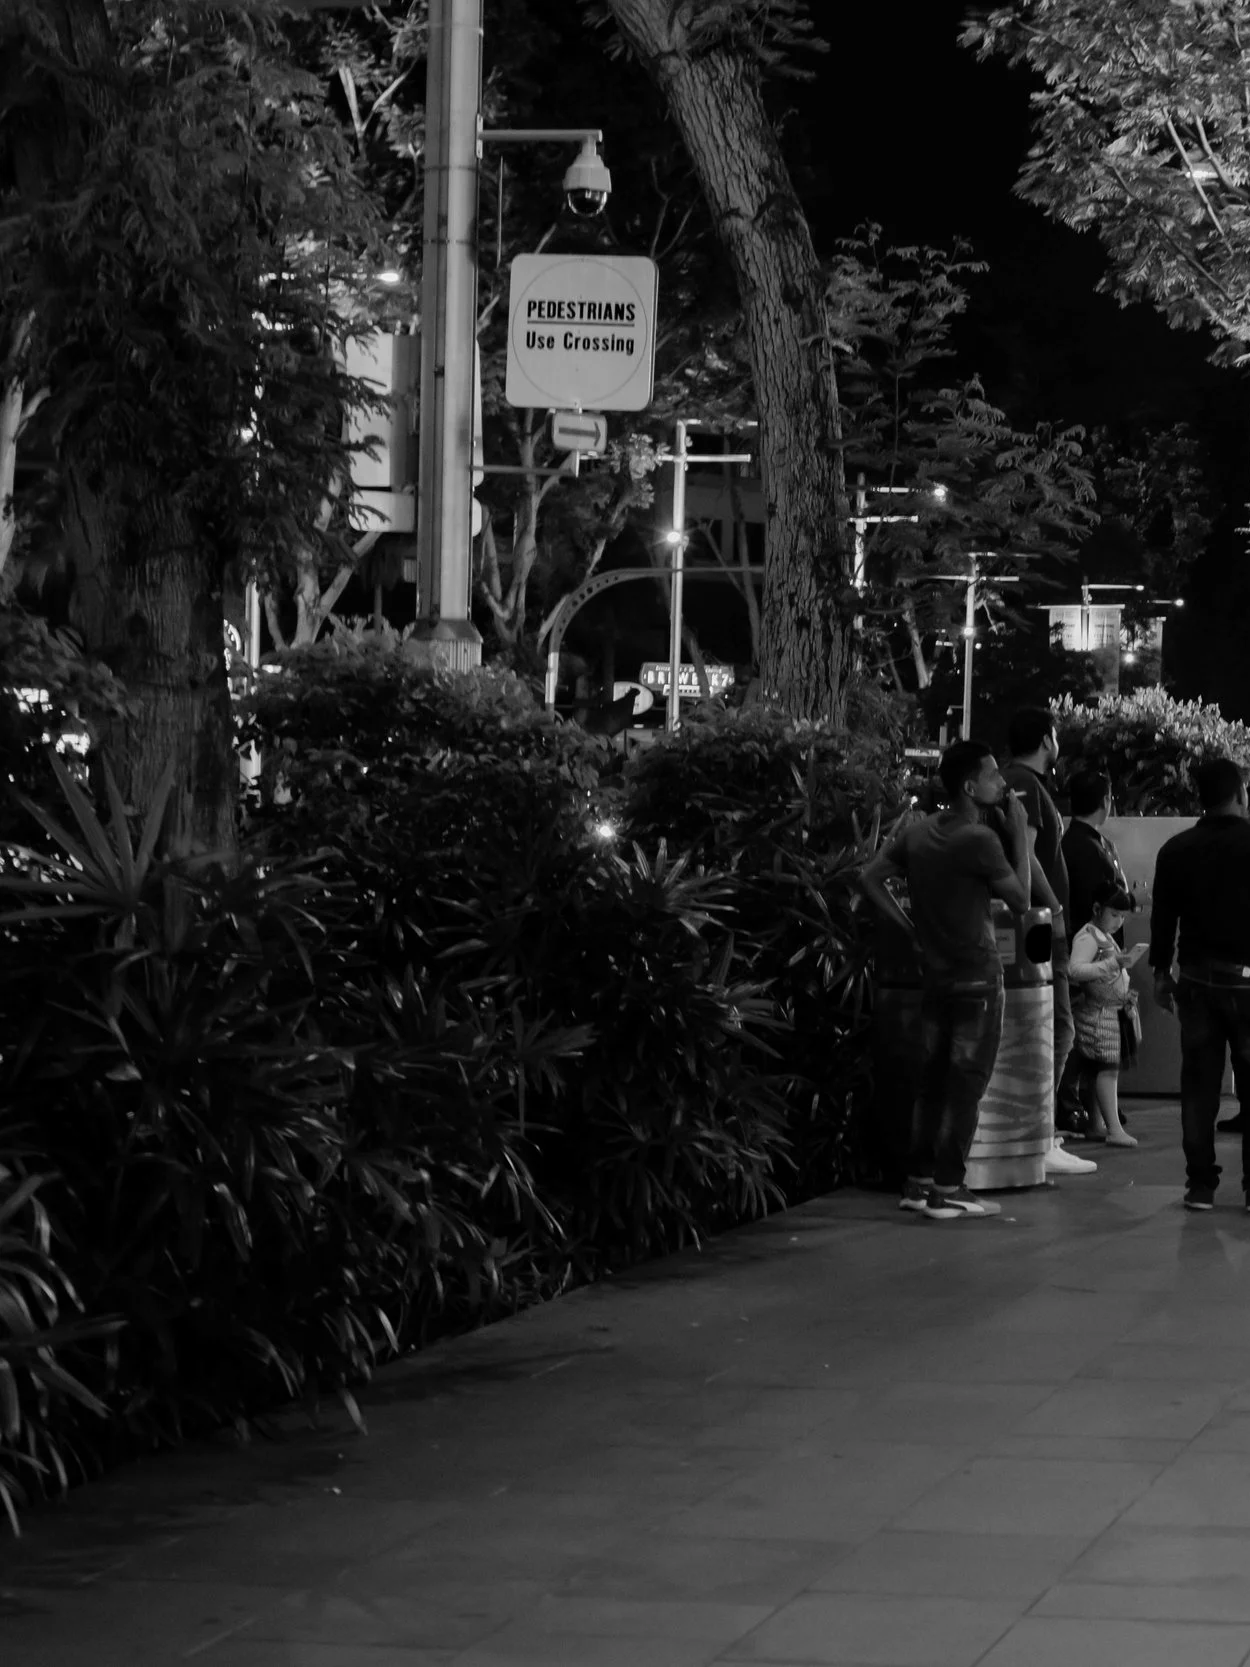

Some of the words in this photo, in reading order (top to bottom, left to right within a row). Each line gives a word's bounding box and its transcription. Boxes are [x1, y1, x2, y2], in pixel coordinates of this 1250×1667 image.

[527, 300, 636, 321] PEDESTRIANS
[526, 331, 555, 350] Use
[563, 332, 635, 356] Crossing
